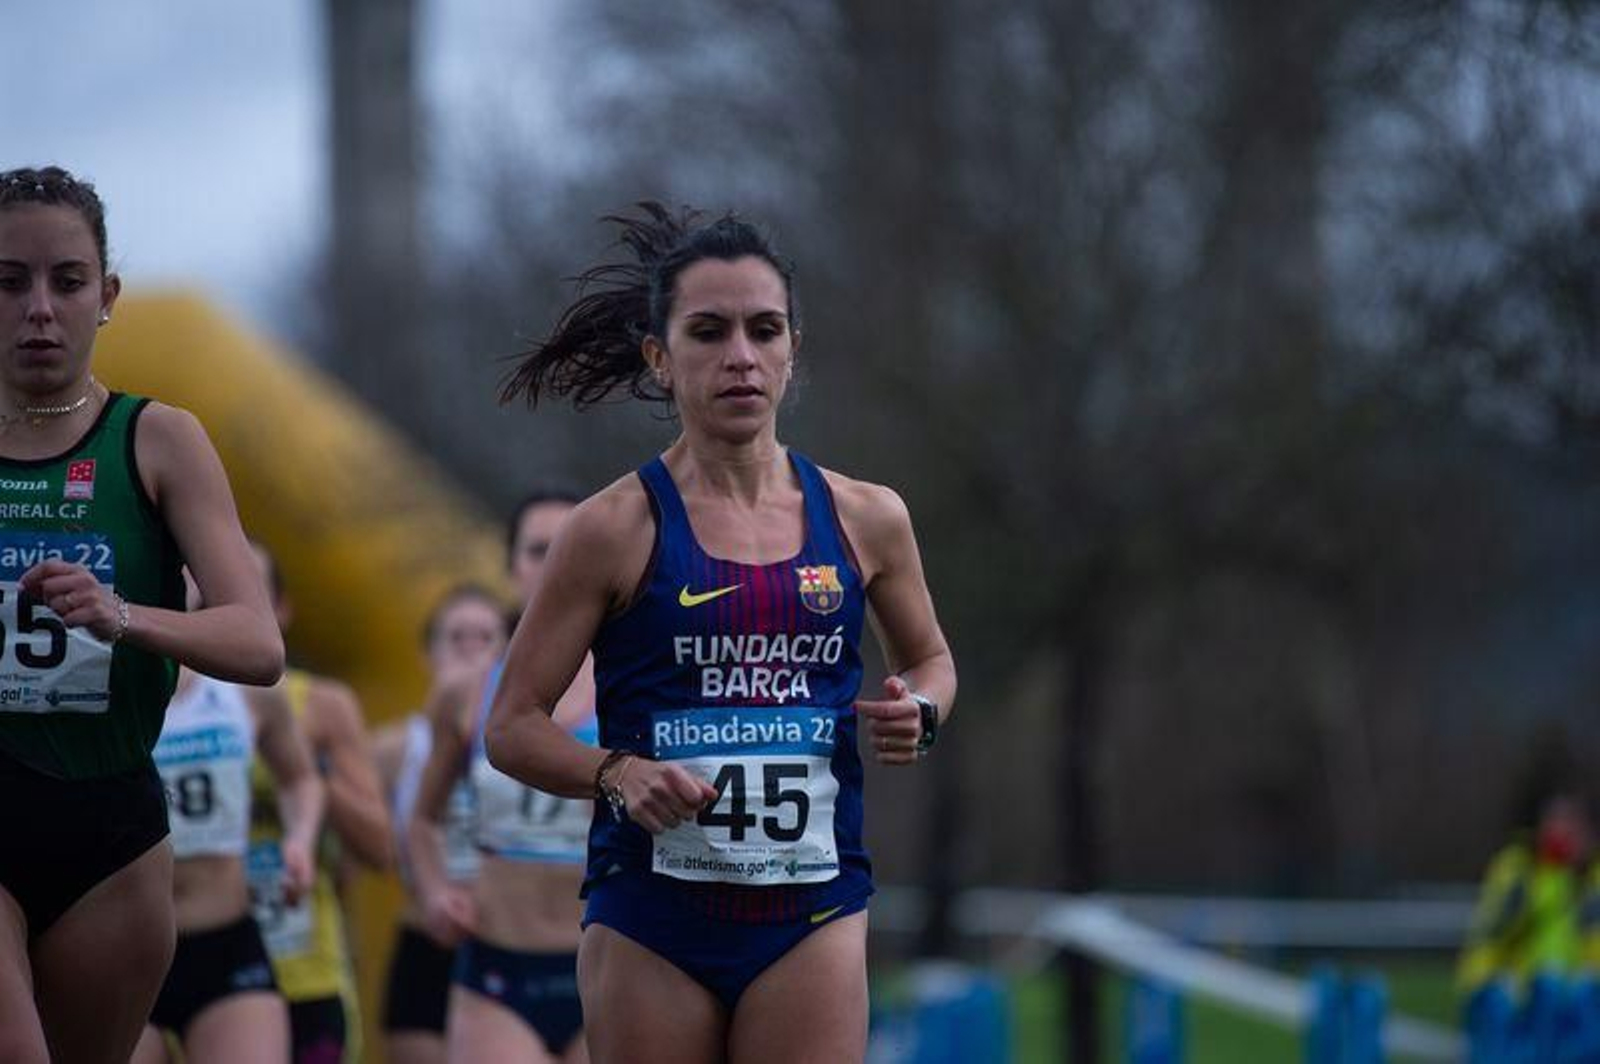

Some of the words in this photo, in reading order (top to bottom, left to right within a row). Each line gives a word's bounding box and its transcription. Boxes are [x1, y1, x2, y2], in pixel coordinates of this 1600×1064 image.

[59, 503, 88, 519] C.F
[75, 543, 112, 570] 22
[0, 588, 68, 669] 5
[674, 625, 844, 665] FUNDACIÓ
[701, 667, 811, 703] BARÇA
[654, 715, 801, 747] Ribadavia
[811, 717, 835, 744] 22
[697, 764, 810, 842] 45
